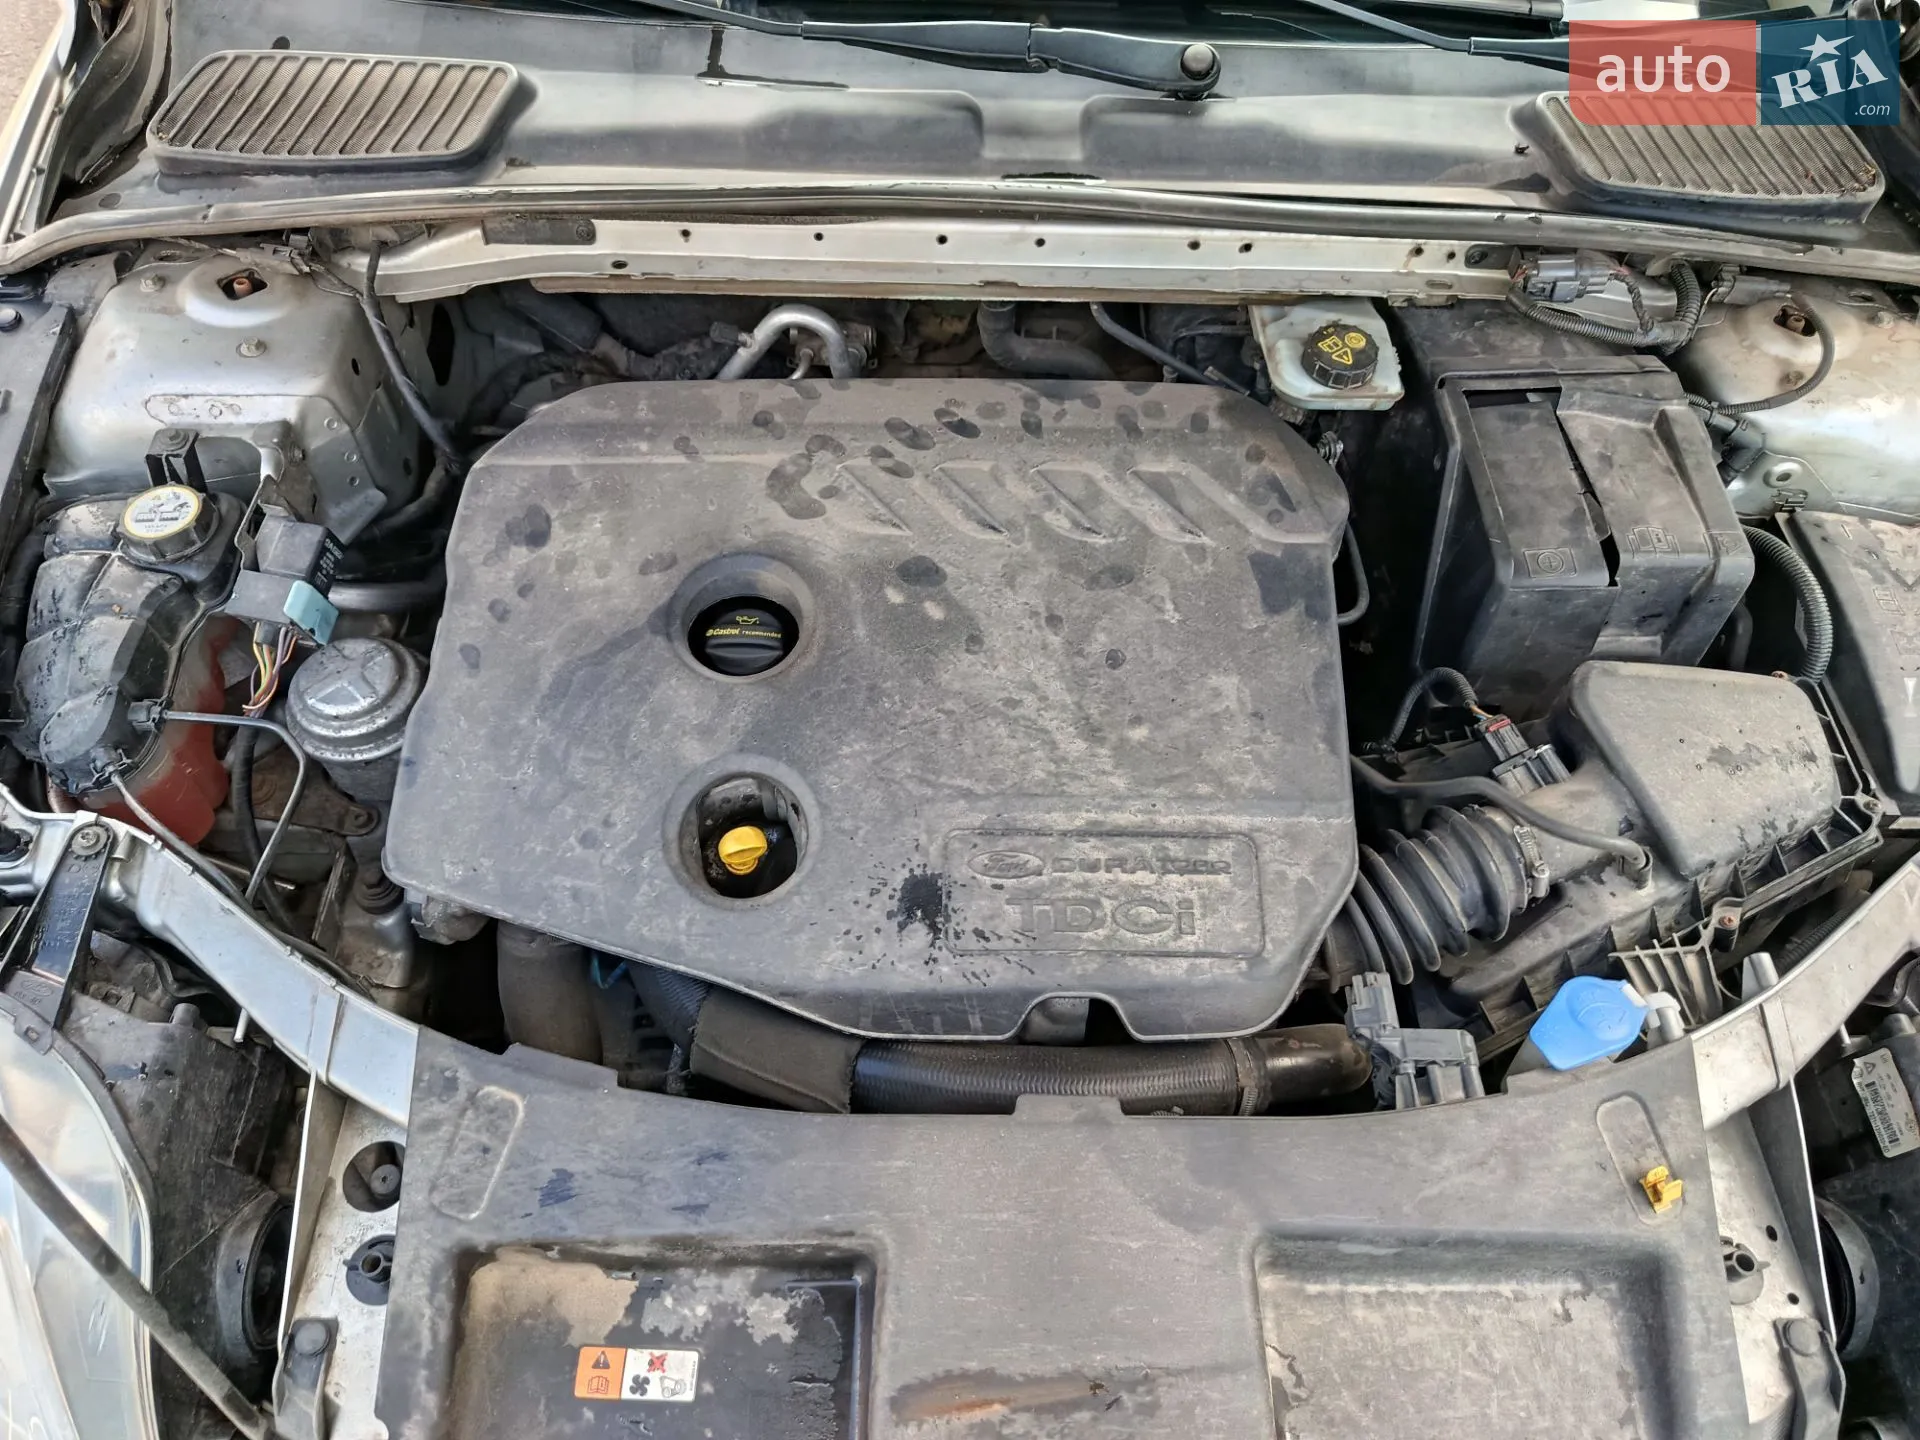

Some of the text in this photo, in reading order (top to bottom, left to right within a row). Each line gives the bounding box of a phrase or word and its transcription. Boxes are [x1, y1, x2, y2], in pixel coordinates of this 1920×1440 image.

[713, 627, 782, 638] Castrol recommended
[1005, 898, 1196, 936] TDCi
